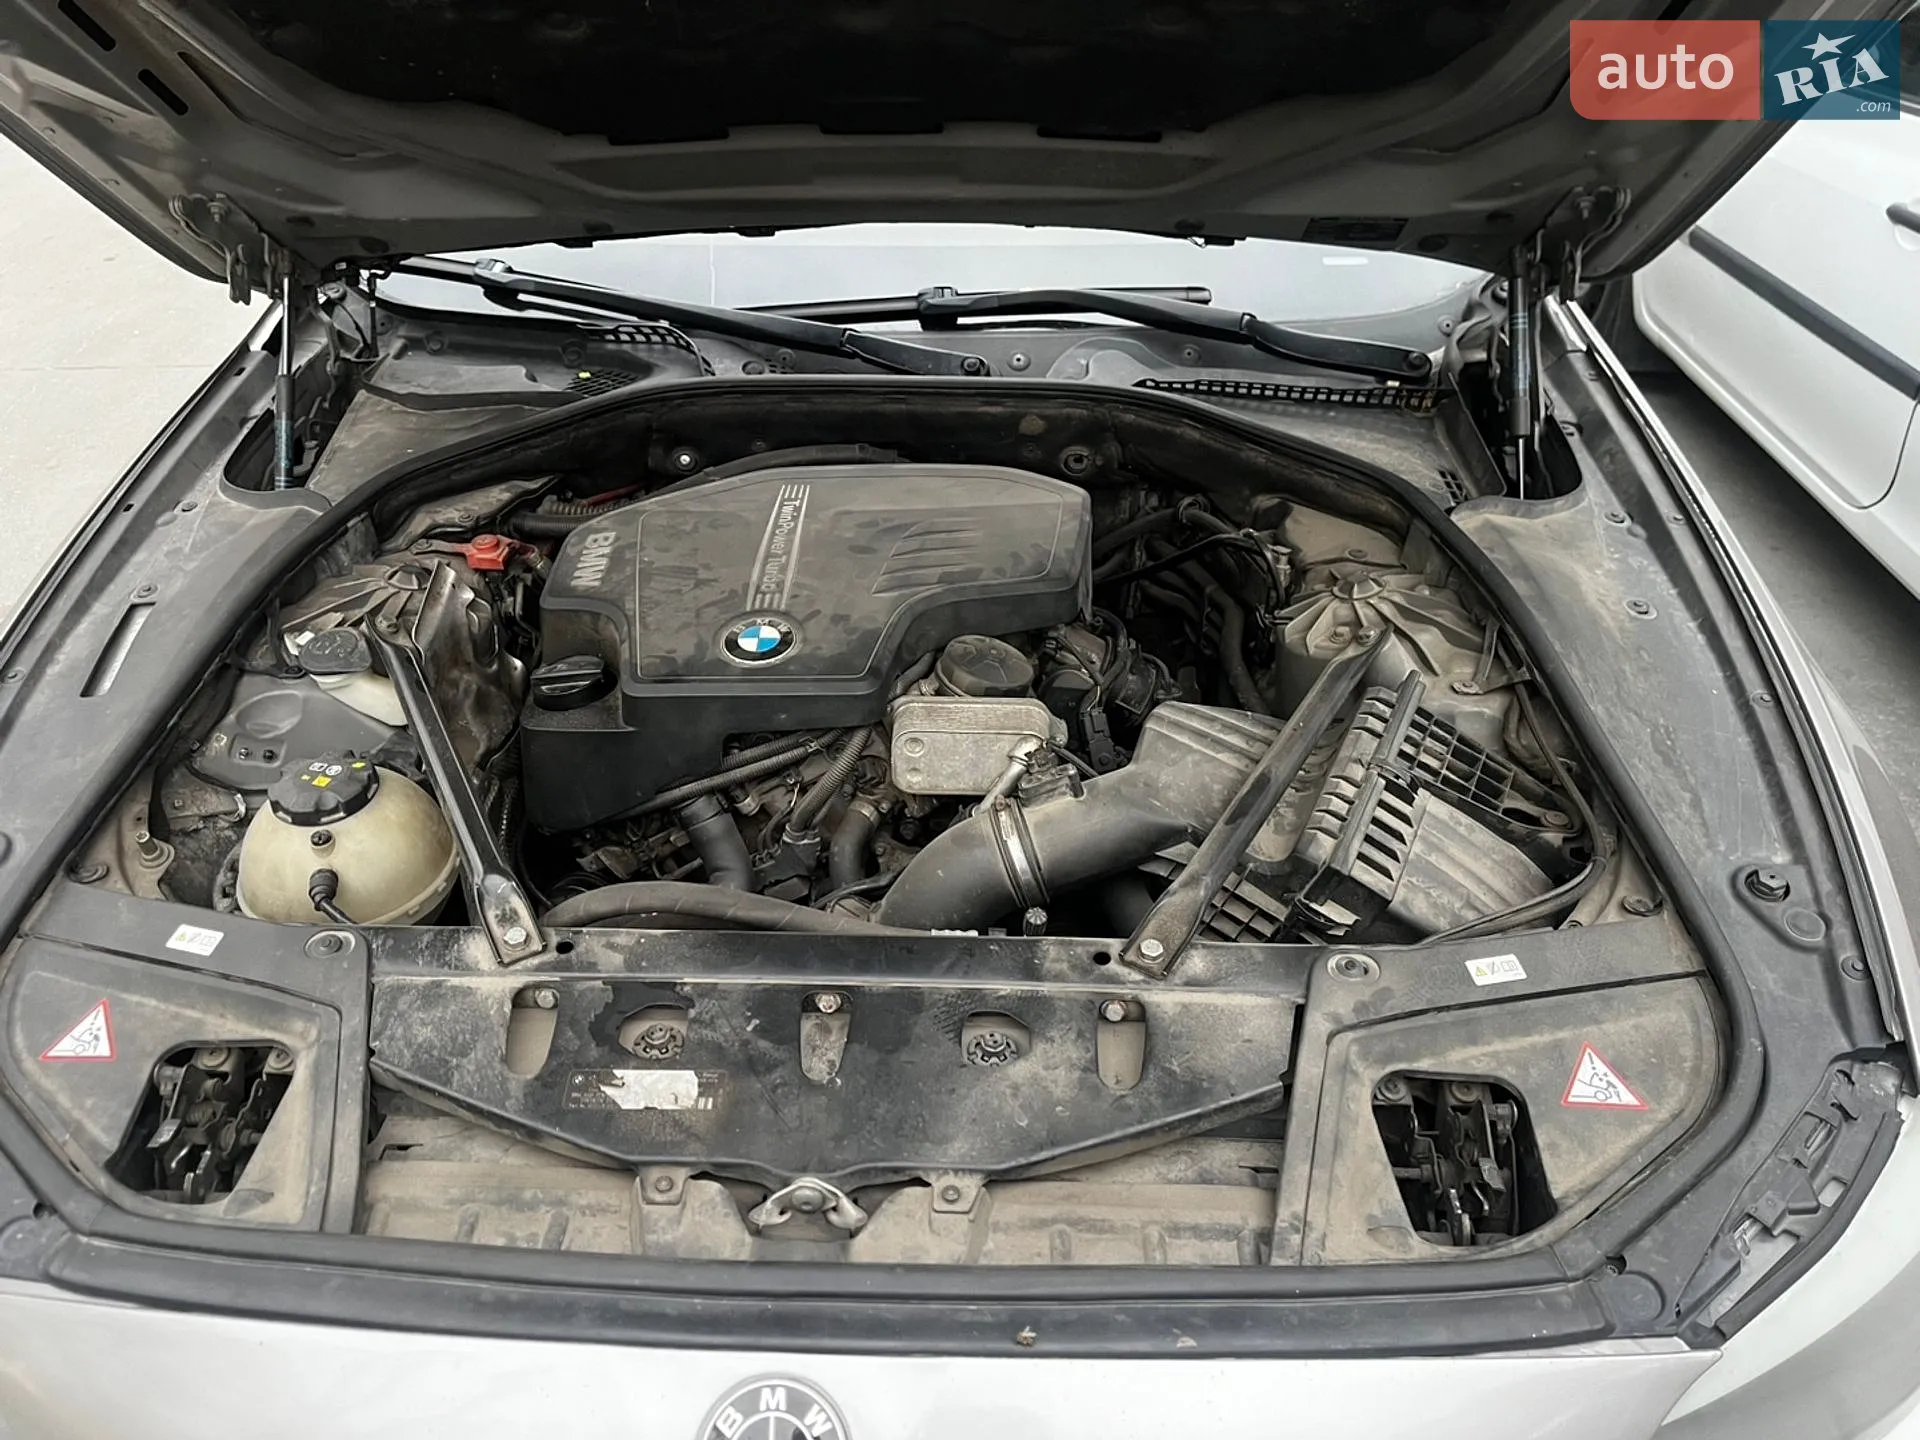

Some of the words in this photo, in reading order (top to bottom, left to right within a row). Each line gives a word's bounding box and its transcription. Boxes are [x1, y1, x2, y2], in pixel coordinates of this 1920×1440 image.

[770, 499, 800, 554] TwinPower
[570, 531, 617, 587] BMW
[715, 1386, 833, 1439] BMW
